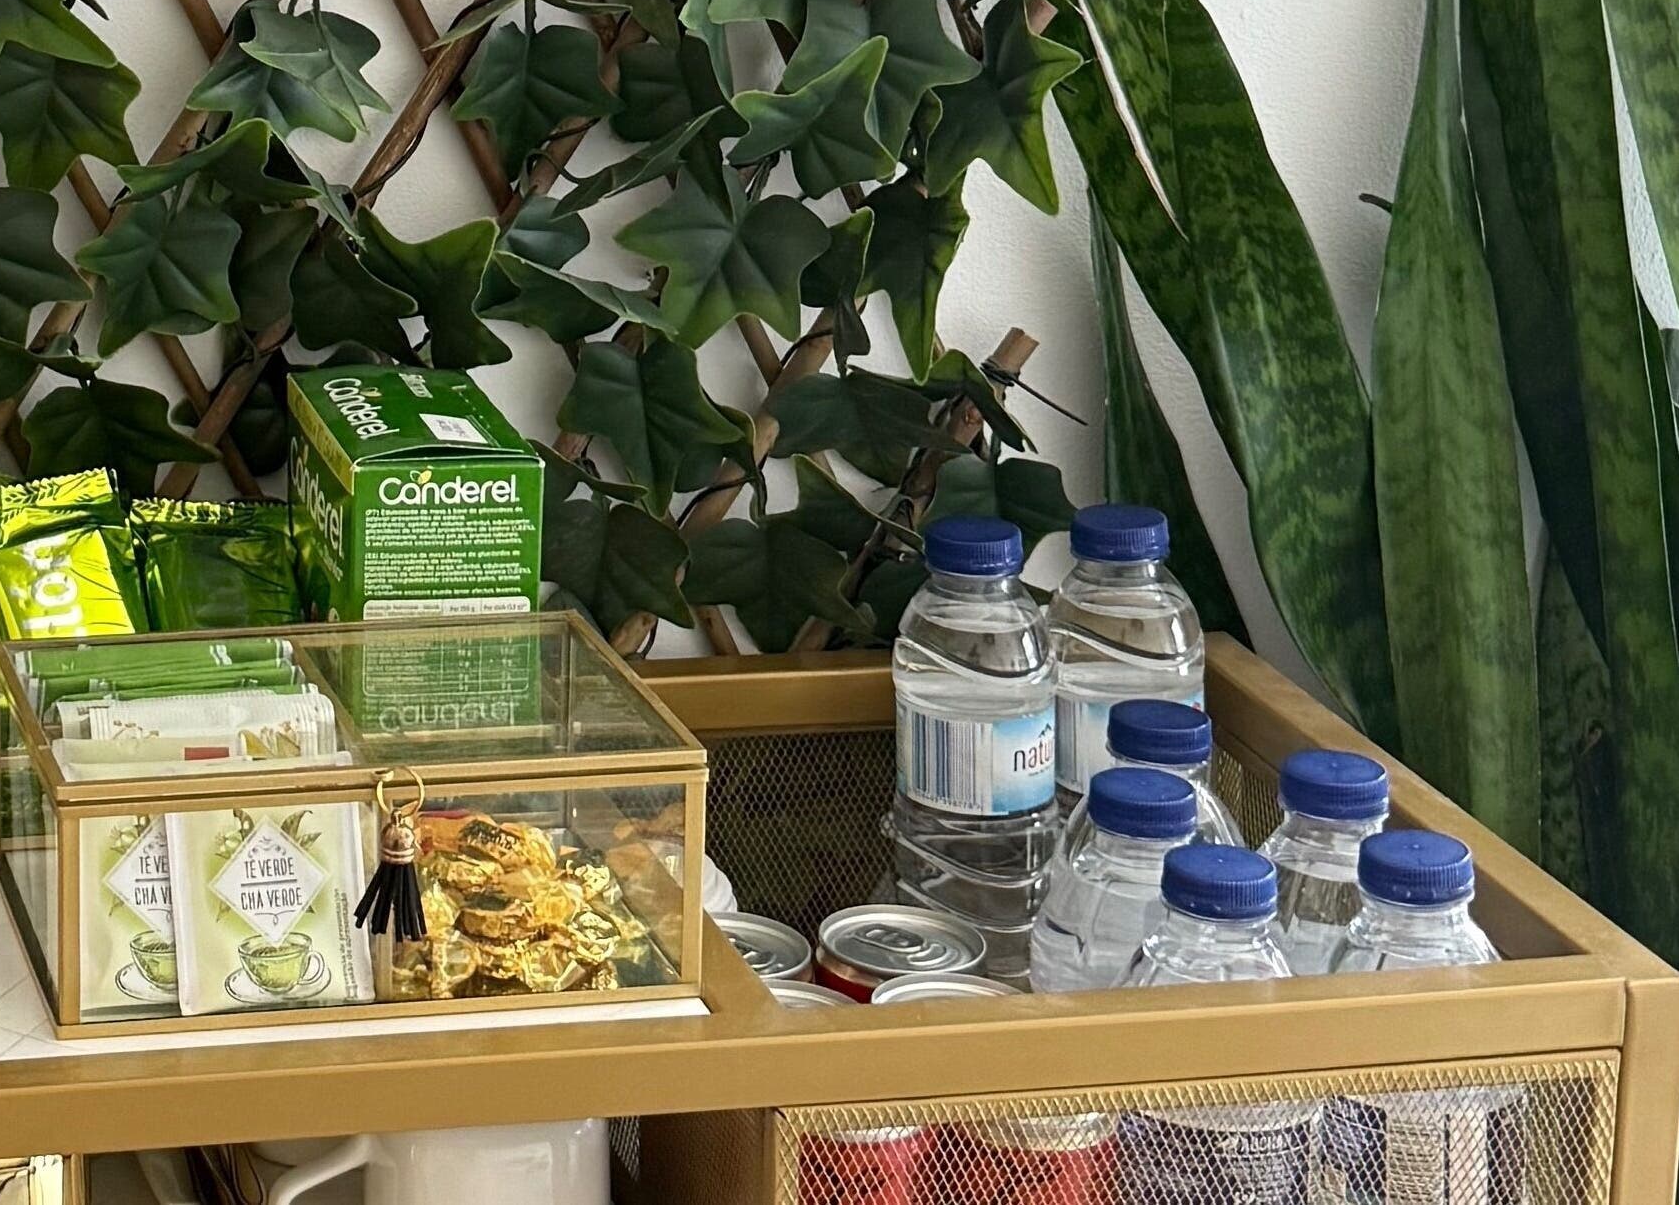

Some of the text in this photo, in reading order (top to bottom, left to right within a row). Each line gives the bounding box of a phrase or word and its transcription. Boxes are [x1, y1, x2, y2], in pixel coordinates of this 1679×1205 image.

[323, 377, 401, 441] Canderel
[290, 436, 345, 559] Canderel
[378, 474, 517, 506] Canderel
[258, 857, 295, 877] VERDE
[266, 887, 303, 908] VERDE
